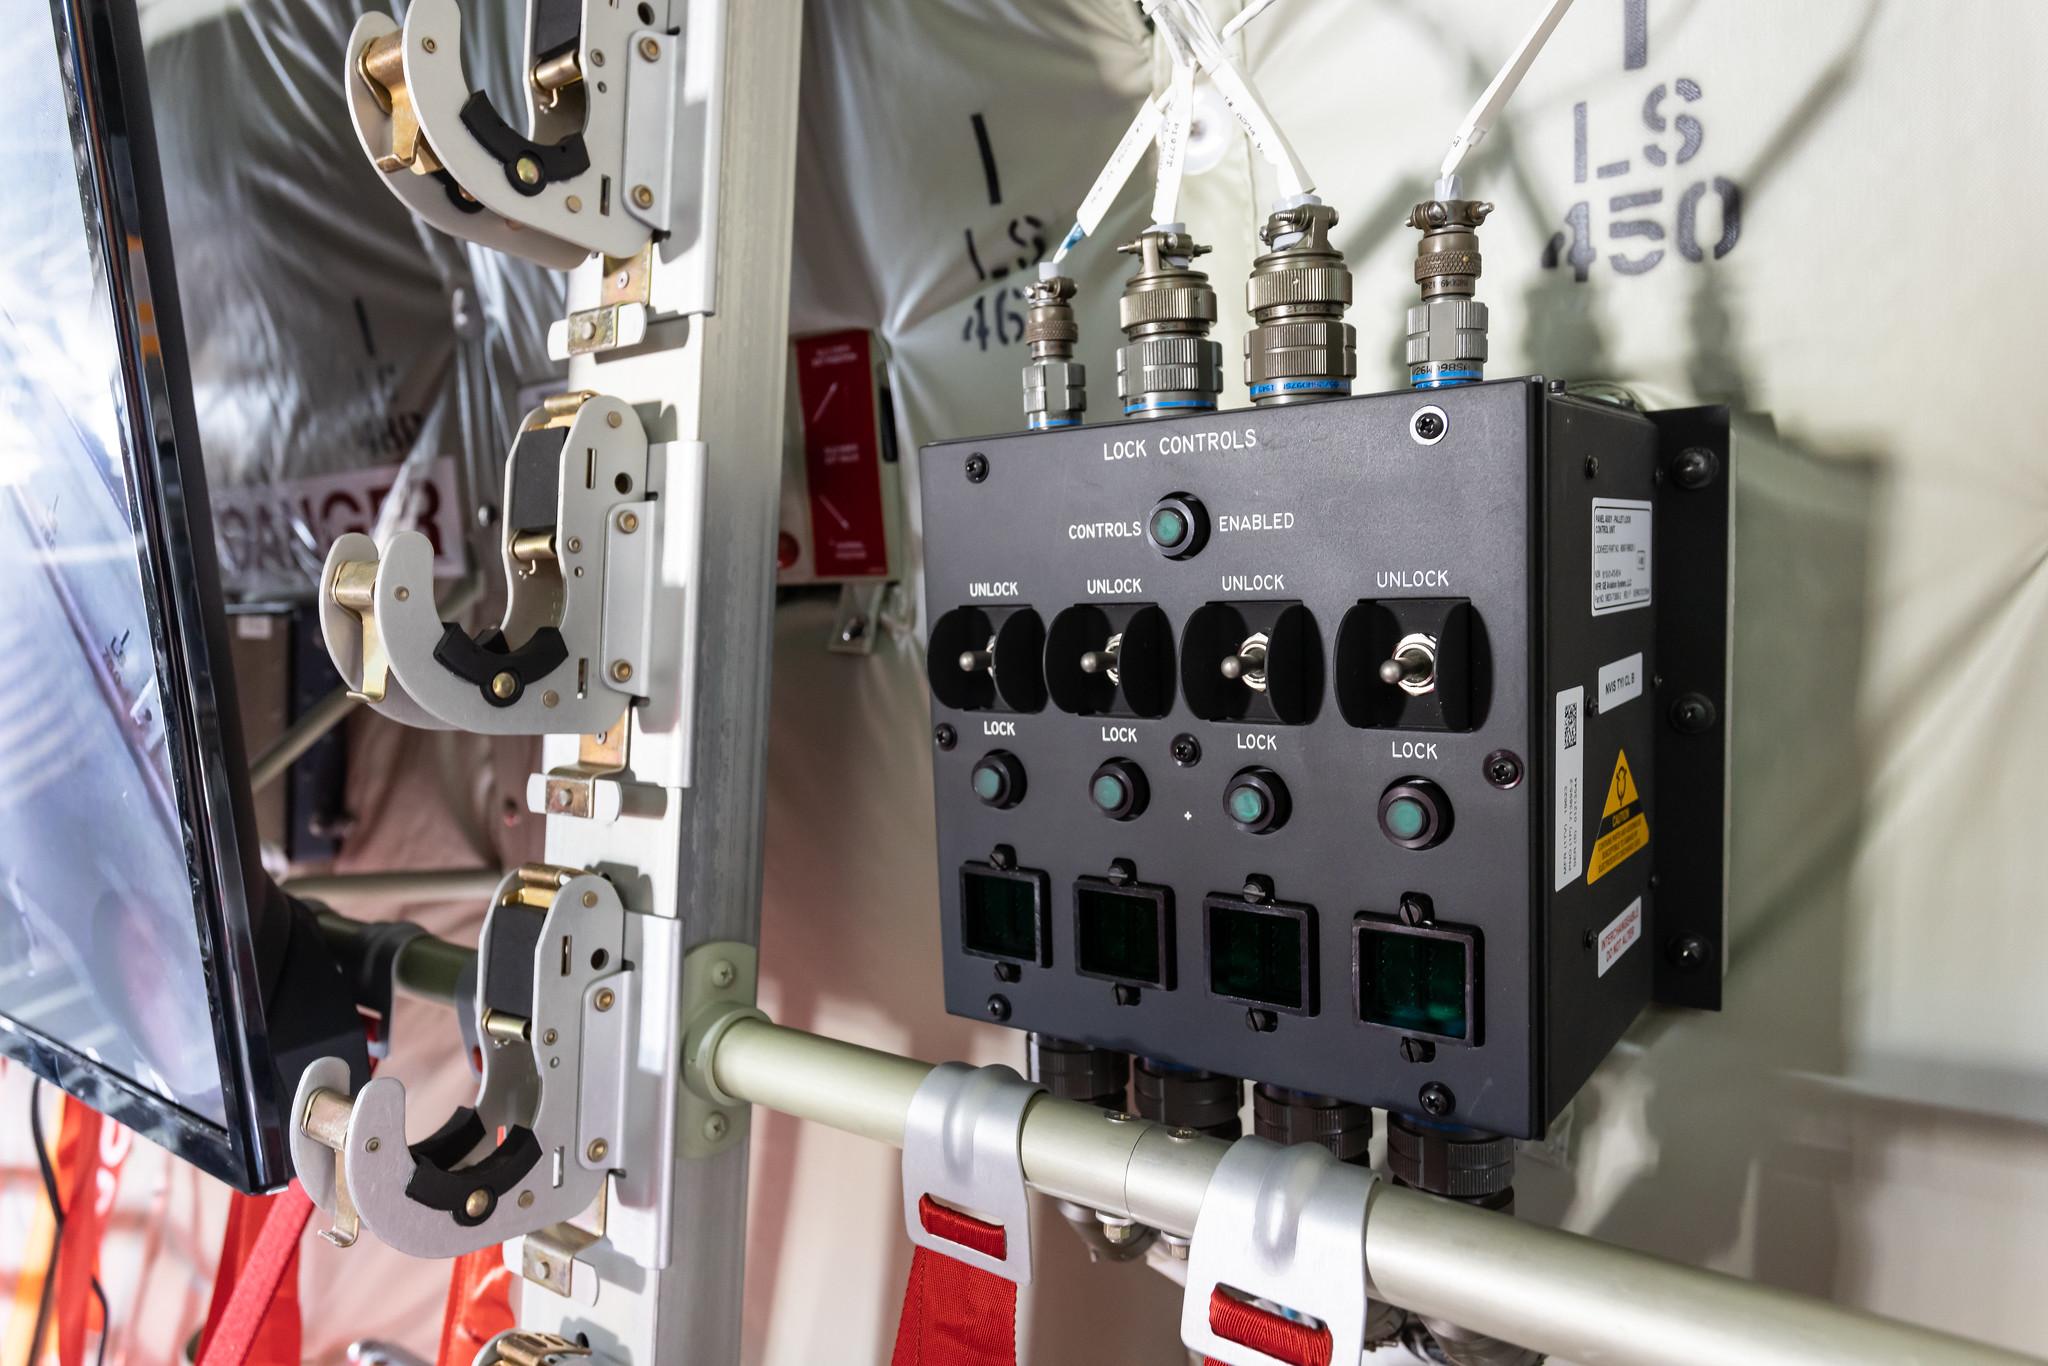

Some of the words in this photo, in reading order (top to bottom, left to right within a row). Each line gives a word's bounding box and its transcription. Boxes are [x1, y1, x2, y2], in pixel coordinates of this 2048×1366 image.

[1573, 78, 1704, 184] LS
[1541, 175, 1743, 283] 450
[964, 214, 1047, 281] LS
[962, 288, 1026, 352] 46
[1103, 439, 1147, 461] LOCK
[1159, 428, 1257, 456] CONTROLS
[1068, 521, 1142, 540] CONTROLS
[1219, 512, 1295, 532] ENABLED
[1087, 578, 1142, 595] UNLOCK
[1222, 574, 1285, 591] UNLOCK
[1376, 570, 1450, 588] UNLOCK
[969, 581, 1019, 597] UNLOCK
[983, 720, 1016, 736] LOCK
[1102, 726, 1138, 743] LOCK
[1237, 733, 1277, 750] LOCK
[1392, 741, 1438, 760] LOCK
